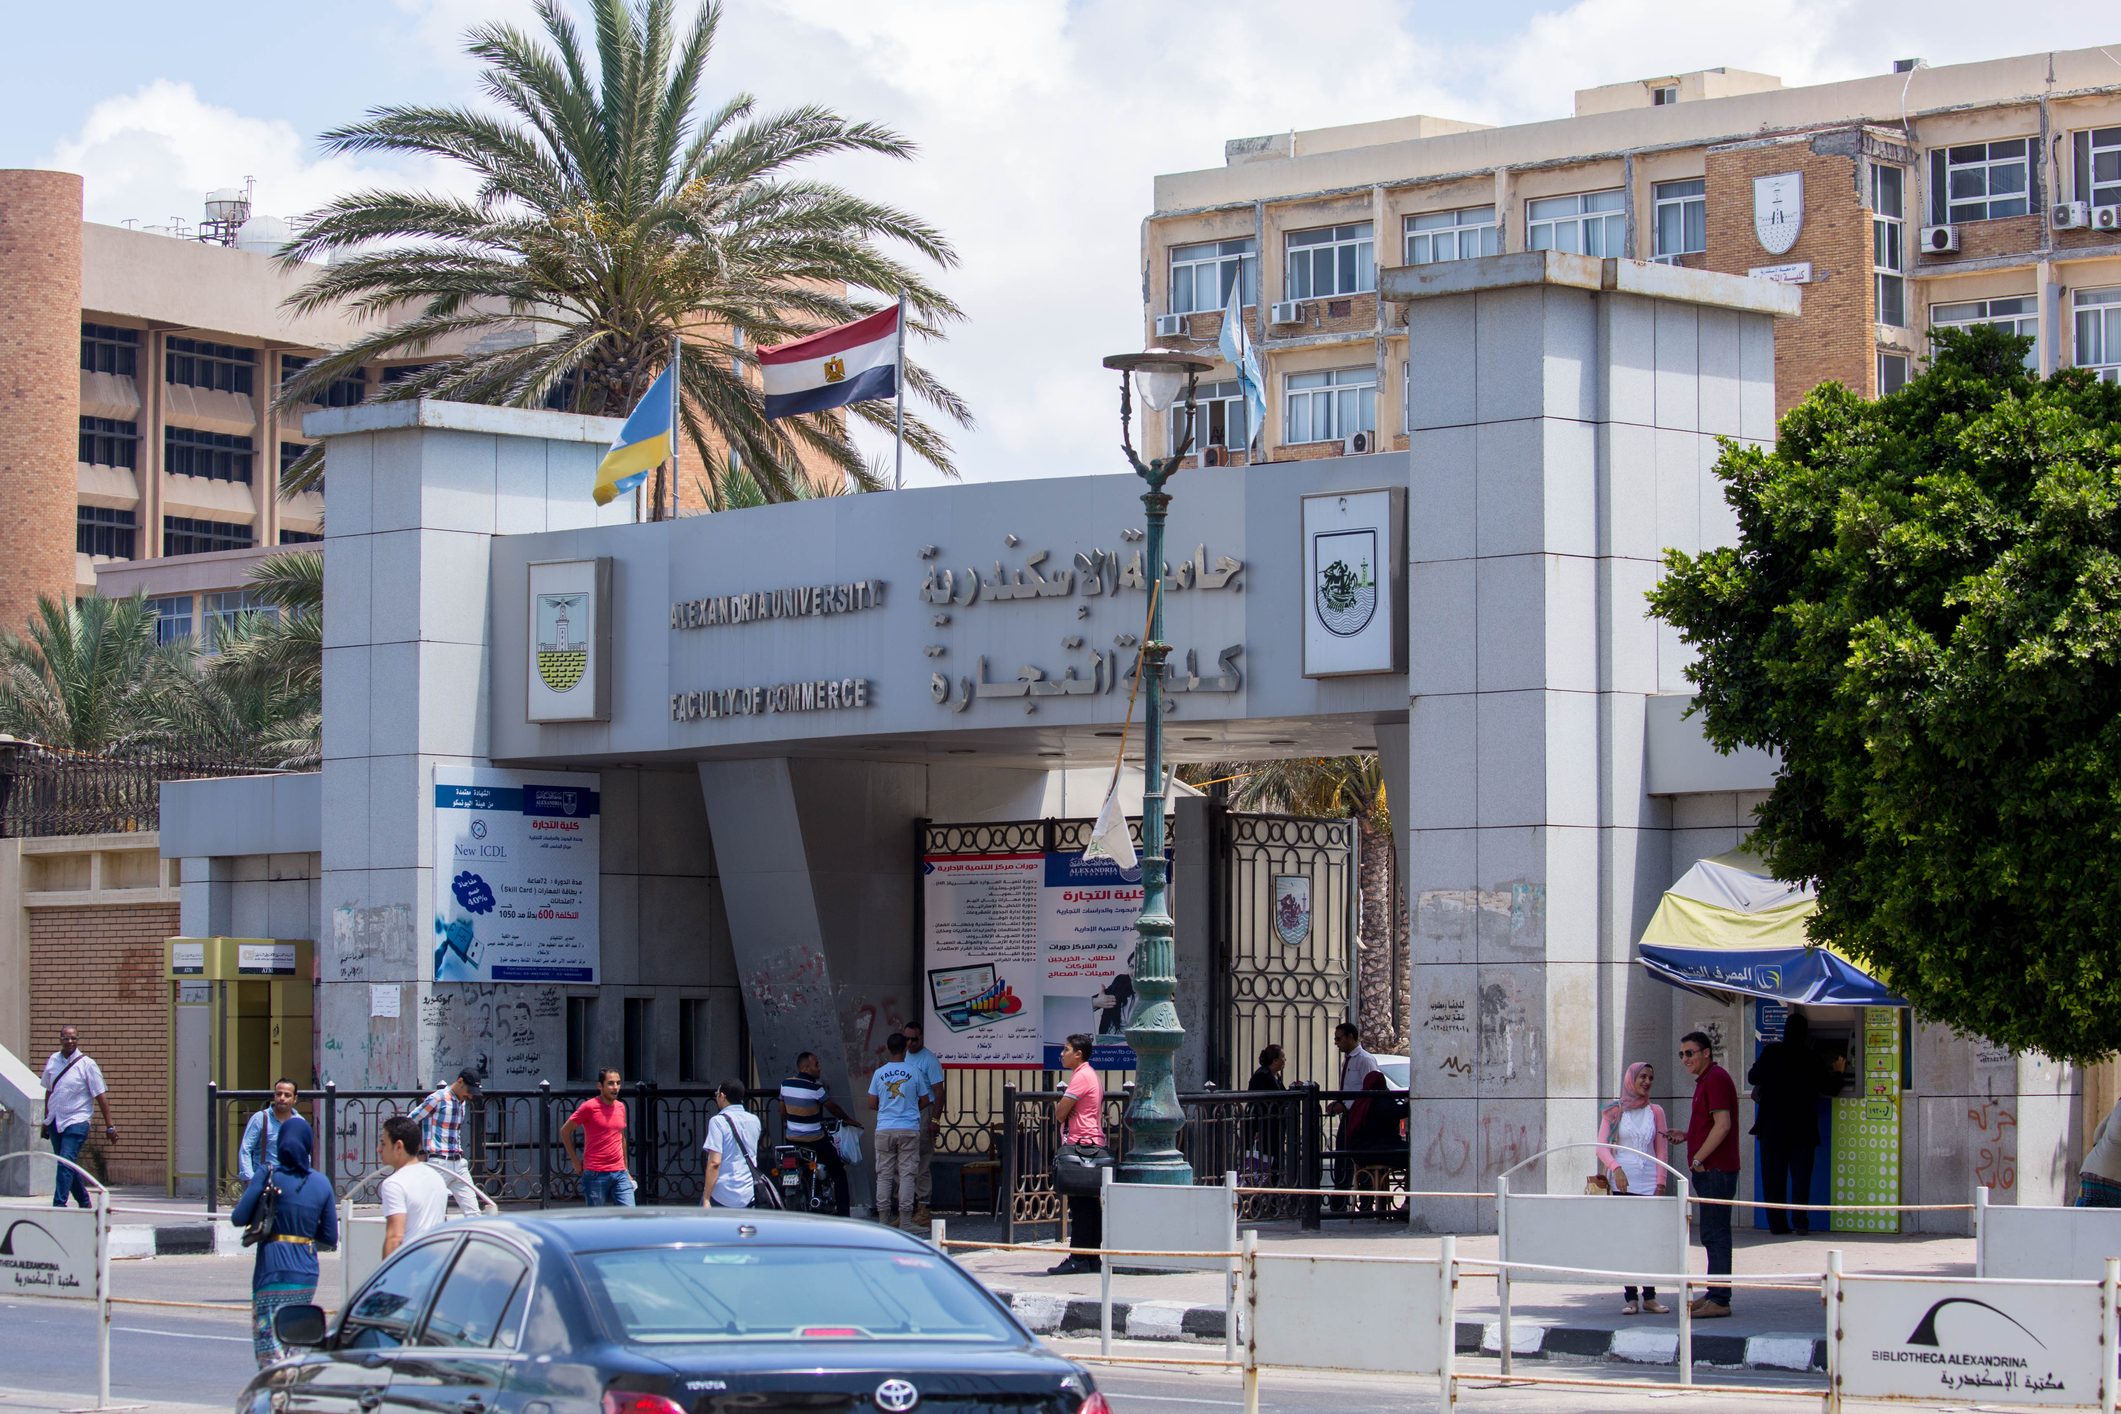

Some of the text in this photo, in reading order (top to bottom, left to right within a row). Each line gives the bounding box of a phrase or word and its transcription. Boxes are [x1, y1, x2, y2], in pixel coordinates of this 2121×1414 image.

[671, 580, 887, 629] ALEXANDRIA UNIVERSITY
[923, 634, 1116, 715] التجارة
[671, 678, 869, 722] FACULTY OF COMMERCE
[532, 820, 579, 830] كلية التجارة
[455, 844, 507, 857] New ICDL
[938, 864, 964, 872] الإدارية
[468, 896, 488, 906] 40%
[1063, 891, 1110, 902] التجارة
[538, 910, 554, 919] 600
[880, 1069, 912, 1081] FALCON
[17, 1261, 59, 1271] ALEXANDRINA
[1872, 1350, 2028, 1368] BIBLIOTHECA ALEXANDRINA
[1940, 1369, 2065, 1394] مكتبة الإسكندرية
